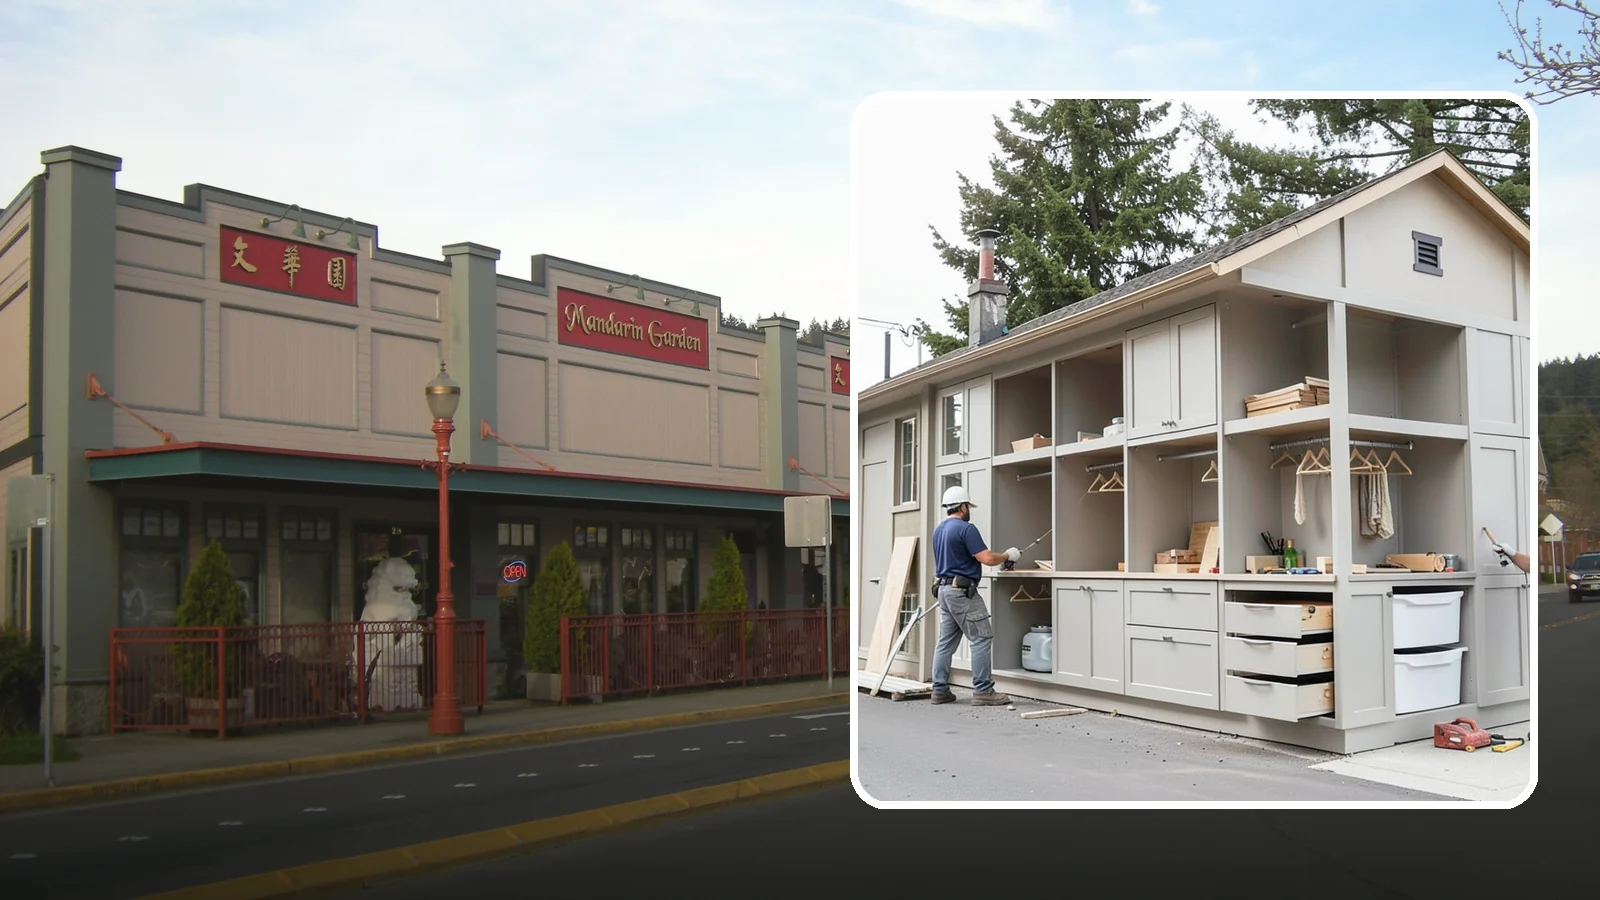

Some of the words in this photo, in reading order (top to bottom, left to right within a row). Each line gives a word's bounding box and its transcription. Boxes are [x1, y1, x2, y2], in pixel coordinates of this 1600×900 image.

[231, 236, 346, 290] 文華園
[564, 302, 644, 341] Mandarin
[648, 320, 701, 352] Garden
[503, 565, 527, 578] OPEN
